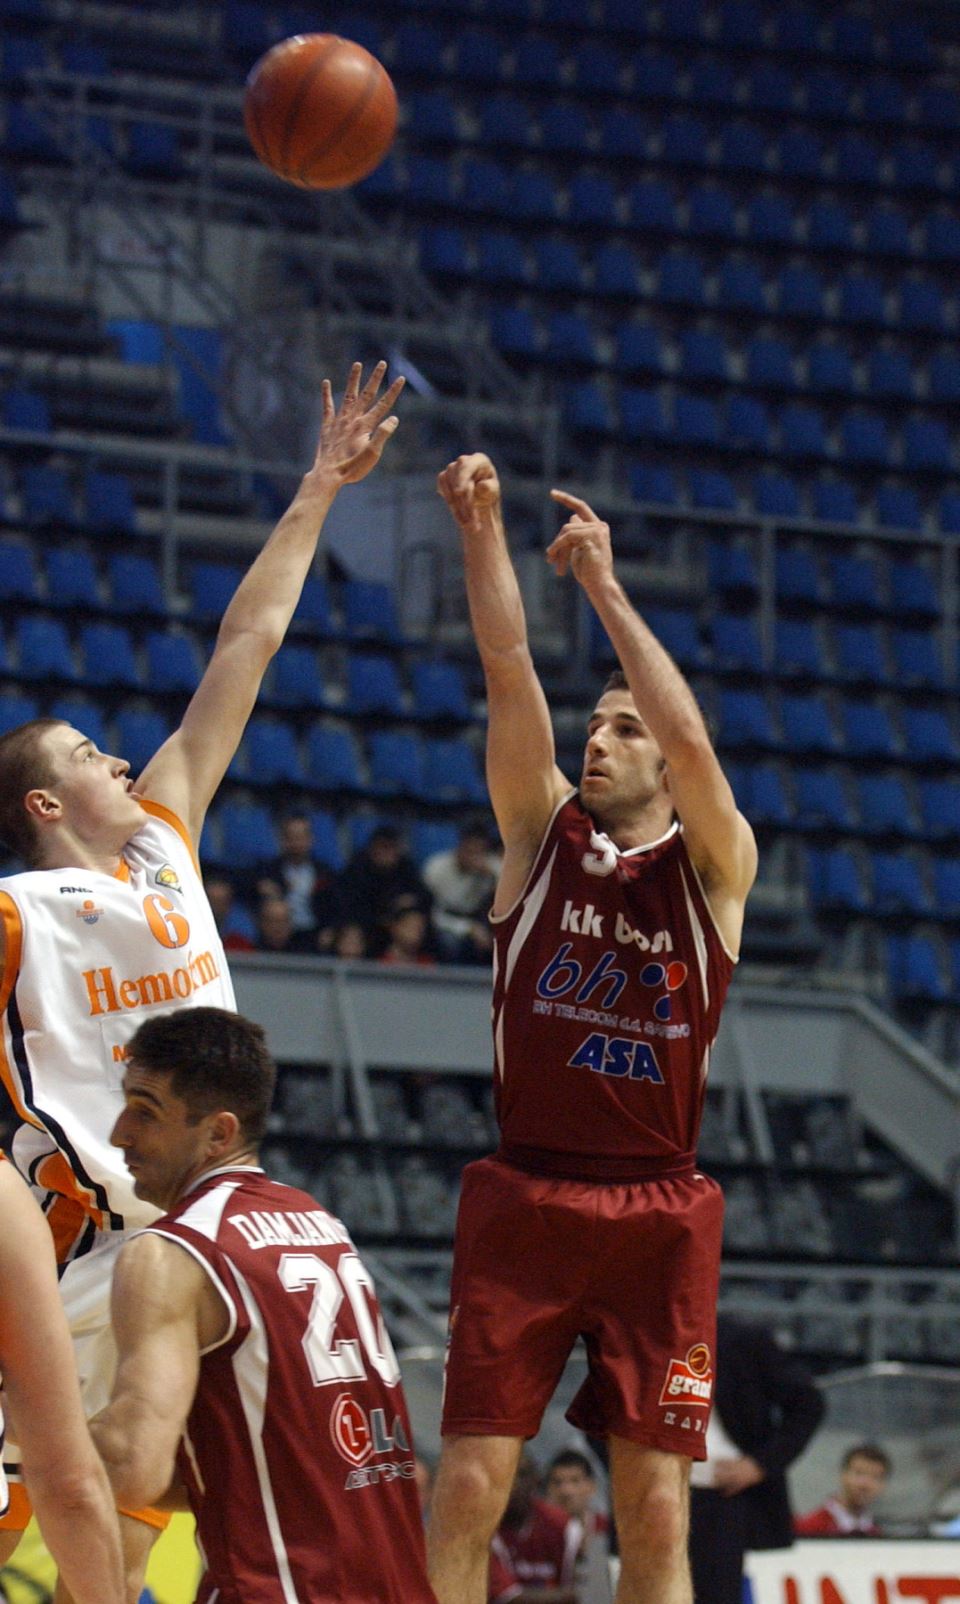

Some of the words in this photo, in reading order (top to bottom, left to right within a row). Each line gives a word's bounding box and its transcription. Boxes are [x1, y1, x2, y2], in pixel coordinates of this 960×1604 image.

[143, 893, 190, 949] 6
[560, 900, 604, 939] kk
[536, 942, 627, 1009] bh
[554, 1003, 619, 1027] TELECOM
[567, 1032, 665, 1085] ASA
[278, 1253, 400, 1387] 20
